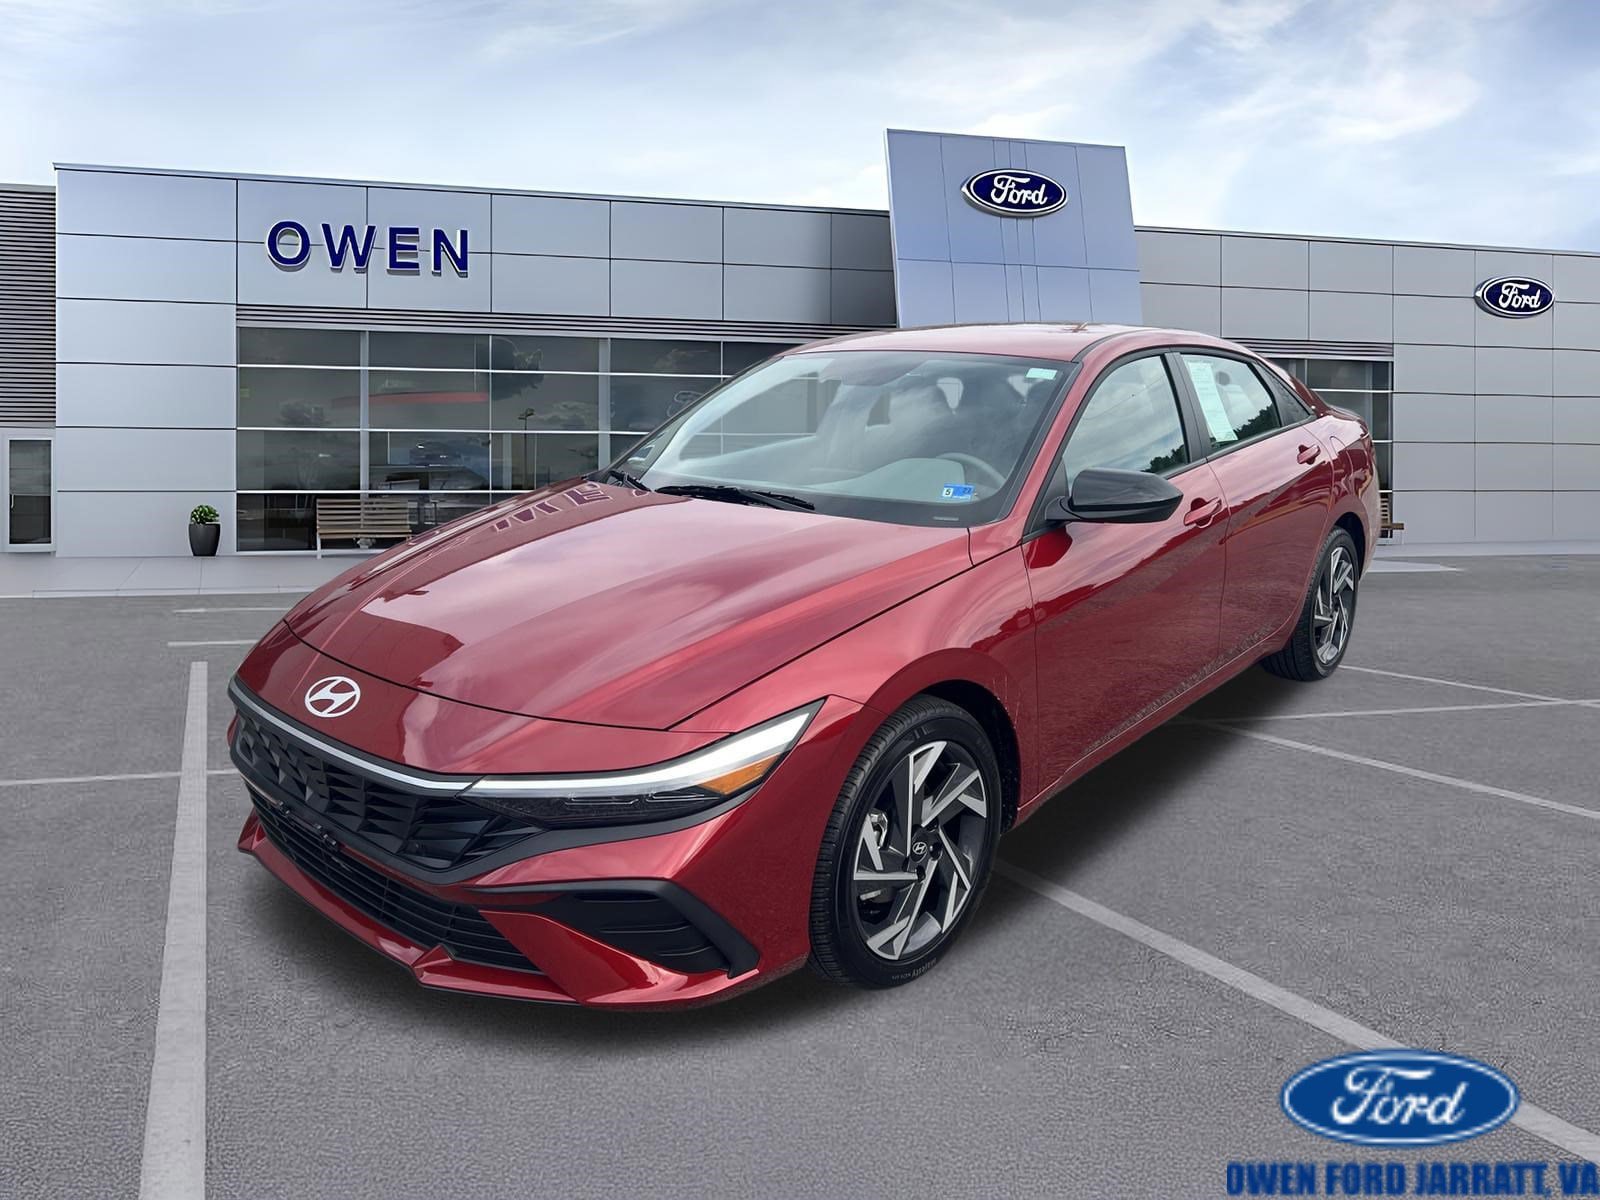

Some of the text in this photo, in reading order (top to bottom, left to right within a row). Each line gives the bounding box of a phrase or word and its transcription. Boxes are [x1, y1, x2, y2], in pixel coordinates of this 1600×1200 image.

[990, 175, 1048, 205] Ford
[266, 220, 469, 276] OWEN
[1498, 282, 1541, 309] Ford
